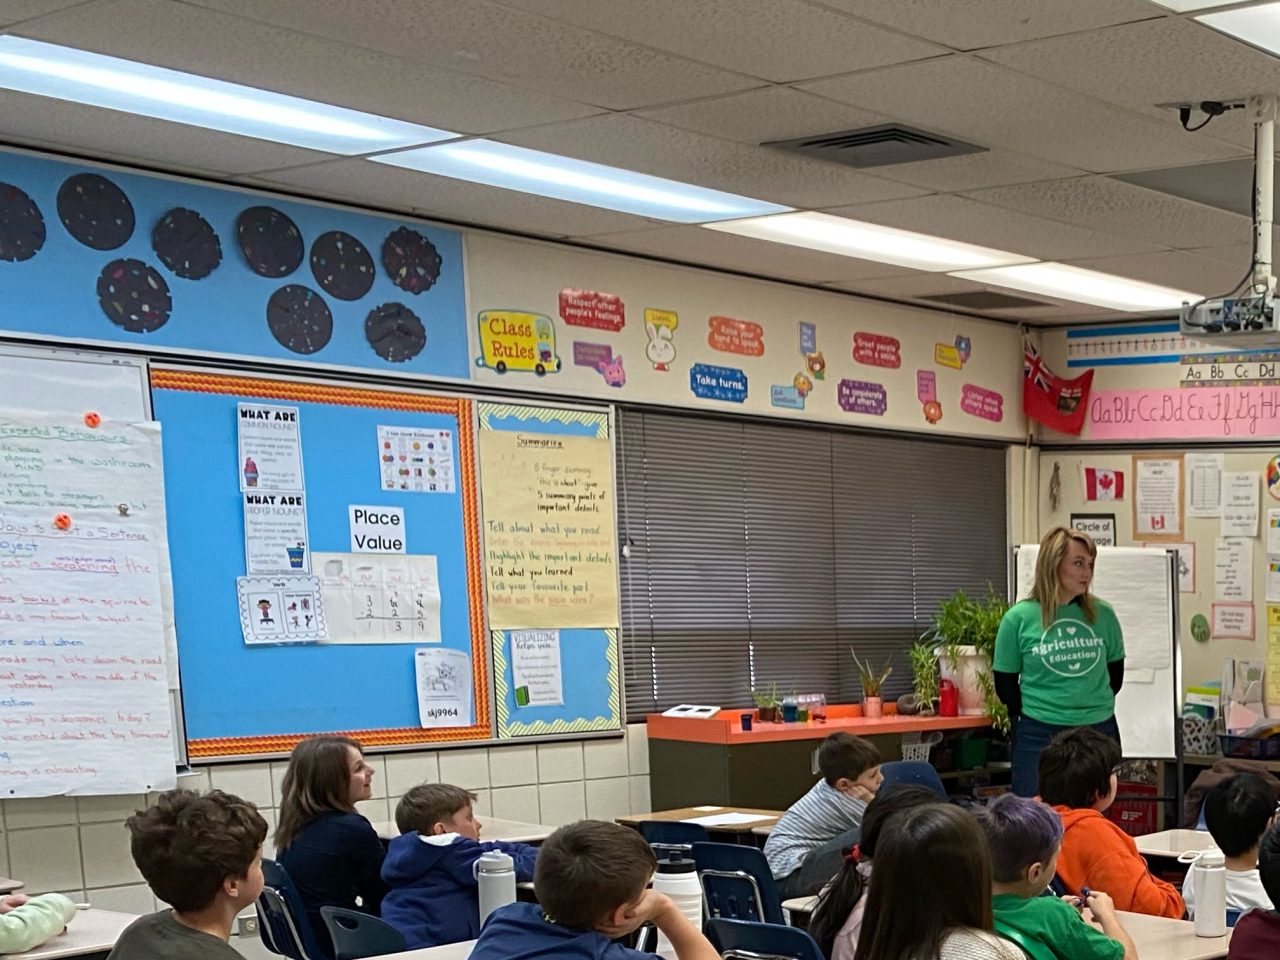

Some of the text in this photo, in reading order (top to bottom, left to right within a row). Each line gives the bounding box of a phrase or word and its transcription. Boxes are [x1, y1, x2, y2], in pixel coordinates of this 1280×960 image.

[568, 296, 616, 311] Respect other
[490, 317, 531, 337] Class
[491, 340, 534, 360] Rules
[1186, 367, 1201, 379] Aa
[1211, 366, 1224, 378] Bb
[1235, 365, 1249, 378] Cc
[1259, 363, 1275, 377] Dd
[696, 374, 744, 390] Take turns.
[843, 387, 882, 399] Be considerate
[849, 397, 855, 405] of
[241, 409, 295, 421] WHAT ARE
[247, 496, 302, 505] WHAT ARE
[538, 503, 570, 513] important
[354, 509, 400, 525] Place
[488, 520, 576, 537] Tell about what you
[1076, 522, 1110, 531] Circle of
[354, 534, 402, 550] Value
[125, 556, 150, 573] the
[529, 550, 540, 560] the
[545, 552, 582, 565] important
[490, 567, 572, 580] Tell what you learned
[491, 581, 504, 590] Tell
[1057, 628, 1062, 637] I
[23, 636, 84, 646] and when
[1031, 637, 1104, 657] Agriculture
[1050, 651, 1096, 663] Education
